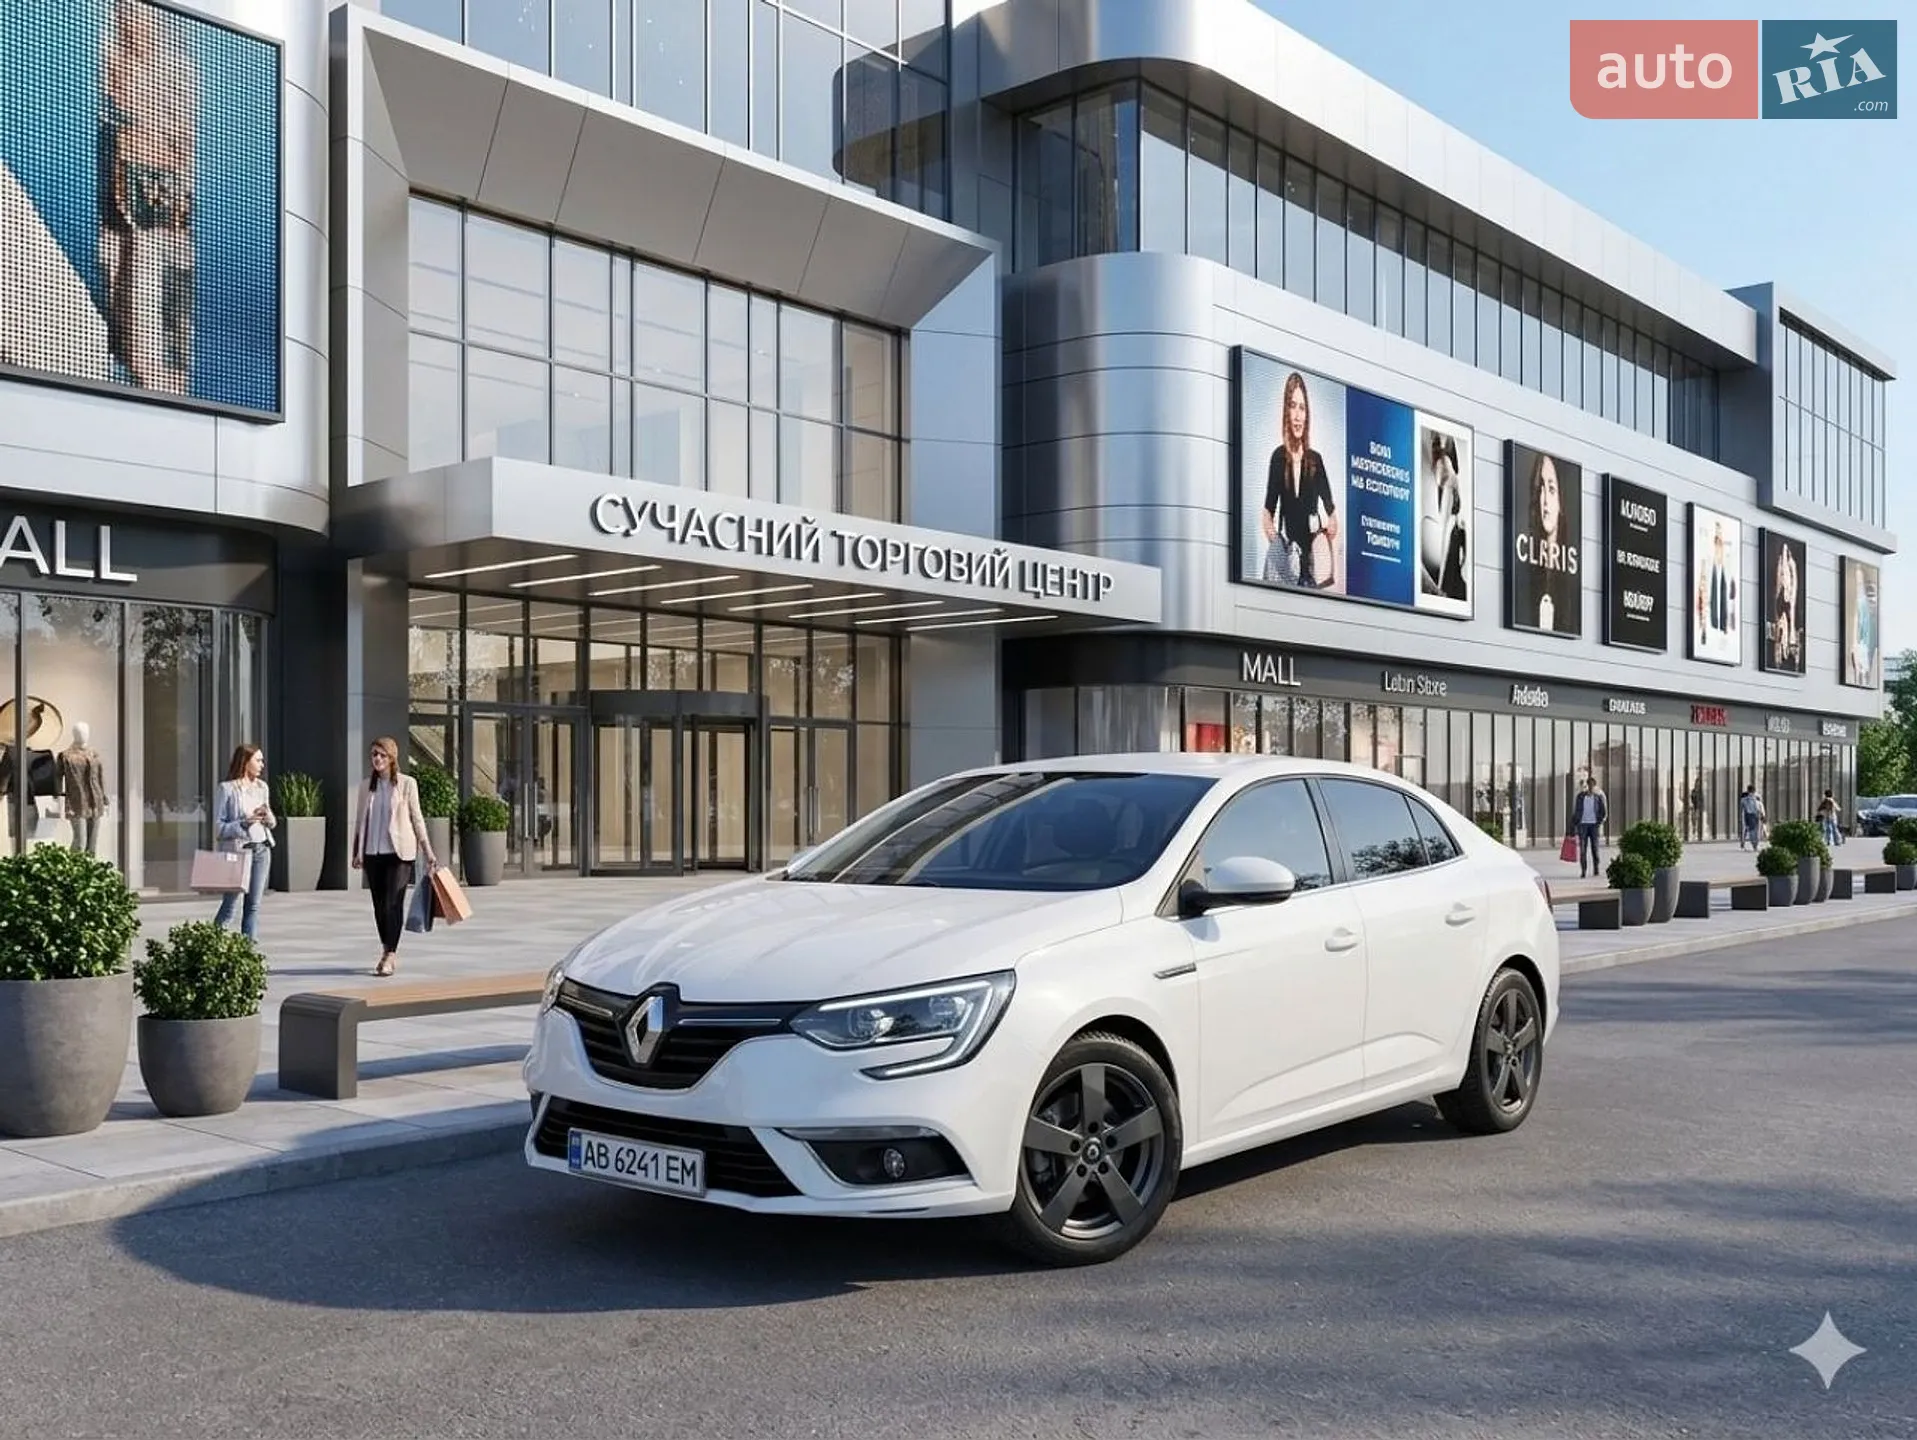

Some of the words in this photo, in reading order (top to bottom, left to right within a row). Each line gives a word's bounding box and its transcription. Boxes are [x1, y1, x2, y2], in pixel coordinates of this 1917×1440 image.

[592, 491, 821, 565] СУЧАСНИЙ
[831, 528, 1012, 589] ТОРГОВИЙ
[1018, 558, 1115, 602] ЦЕНТР
[1242, 652, 1301, 686] MALL
[583, 1139, 610, 1169] AB
[614, 1146, 660, 1181] 6241
[666, 1155, 698, 1188] EM
